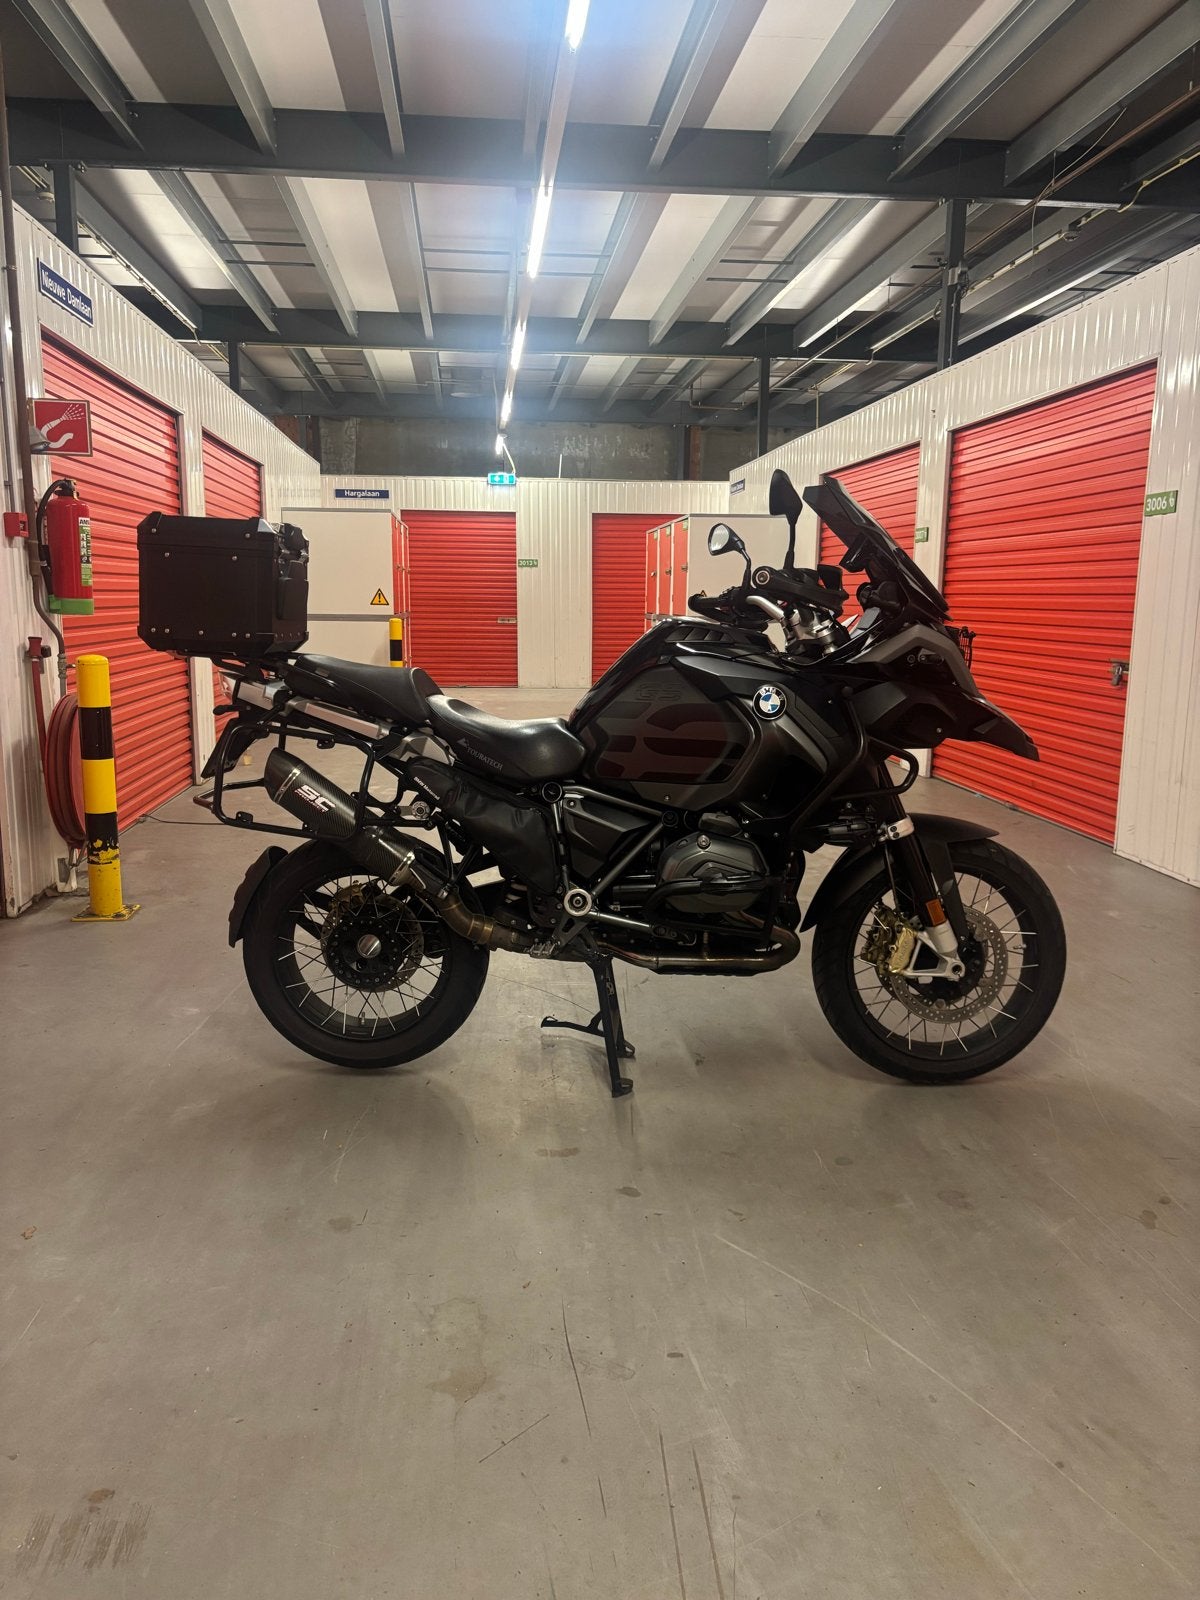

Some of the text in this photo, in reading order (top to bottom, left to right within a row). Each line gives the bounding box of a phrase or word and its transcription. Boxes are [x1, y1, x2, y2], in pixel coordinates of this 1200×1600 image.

[42, 269, 92, 319] Nieuwe Damlaan
[344, 489, 380, 498] Hargalaan
[1145, 496, 1168, 512] 3006
[759, 686, 785, 701] BMW
[467, 746, 504, 771] TOURATECH
